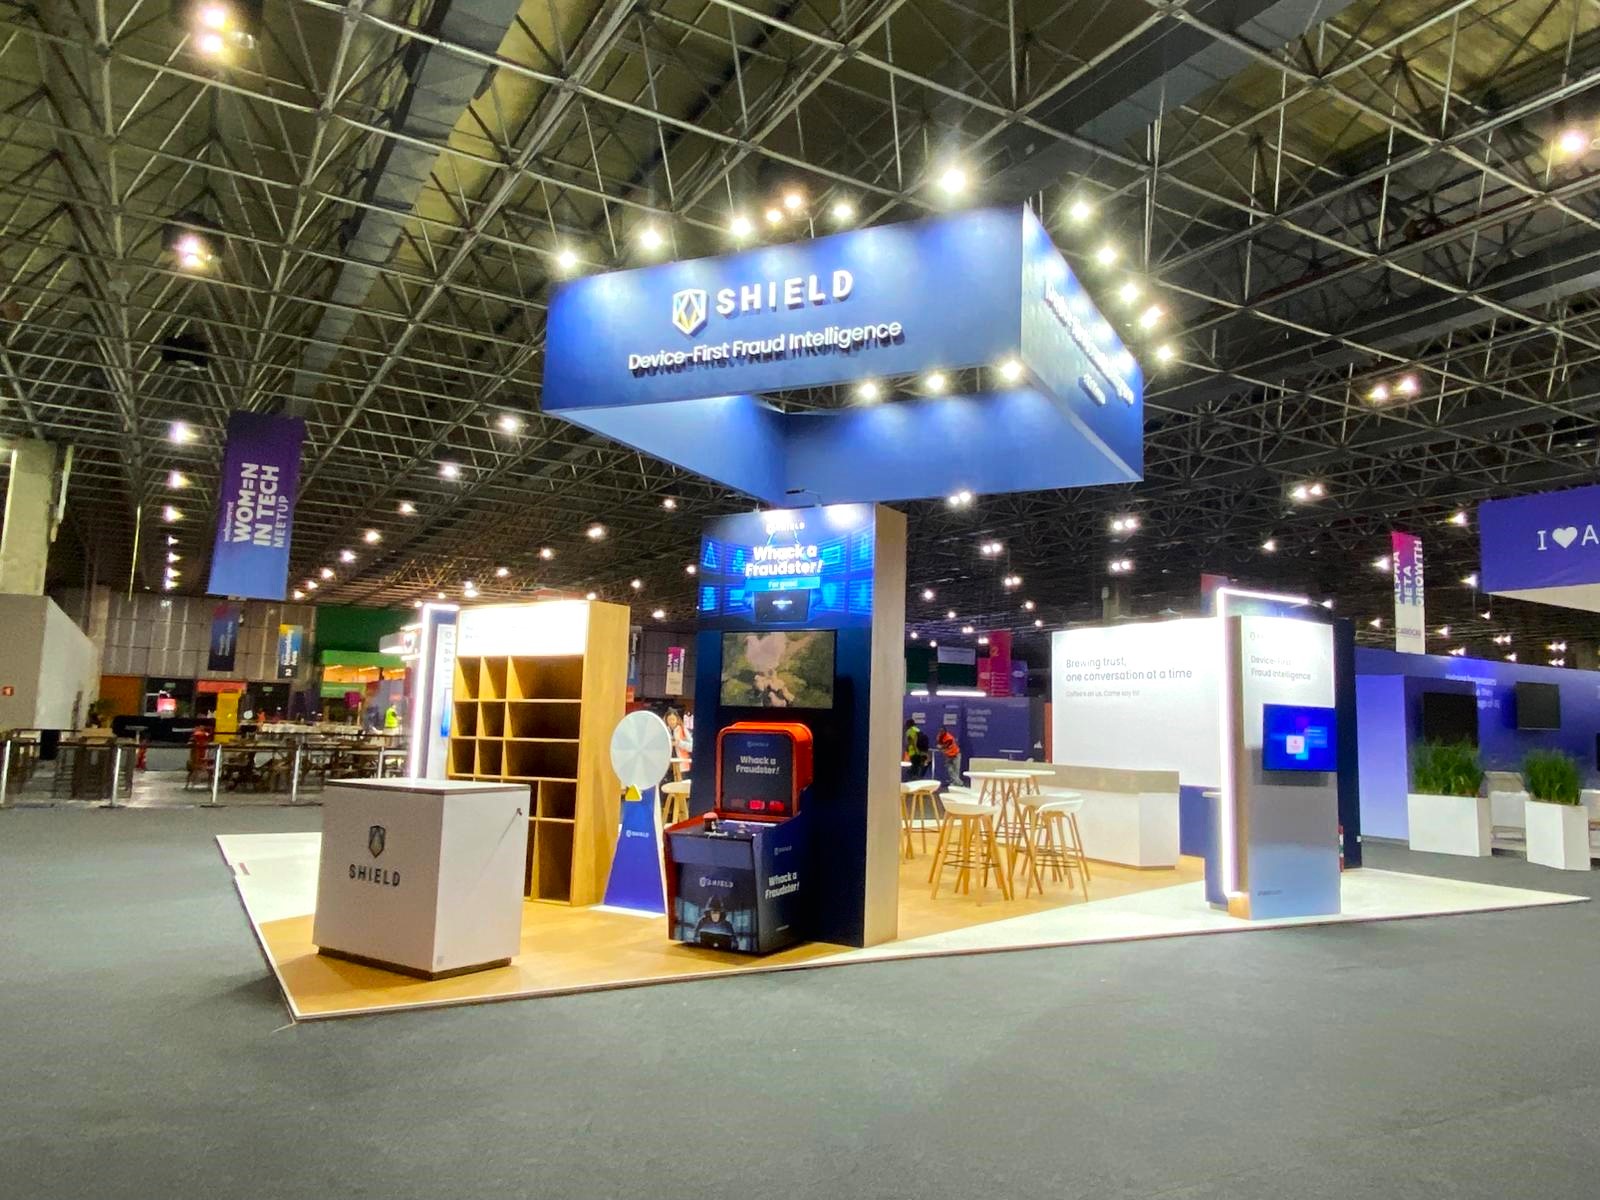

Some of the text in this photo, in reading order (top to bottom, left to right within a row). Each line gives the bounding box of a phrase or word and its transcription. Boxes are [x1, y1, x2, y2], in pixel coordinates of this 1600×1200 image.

[716, 270, 854, 315] SHIELD
[628, 321, 902, 370] Device-First Fraud Intelligence
[253, 465, 280, 546] IN TECH
[273, 495, 289, 548] MEETUP
[1537, 530, 1547, 551] I
[753, 544, 817, 560] Whack a
[745, 559, 824, 577] Fraudster!
[1066, 657, 1127, 670] Brewing trust,
[1066, 668, 1192, 682] one conversation at a time
[740, 755, 769, 765] Whack
[735, 764, 780, 775] Fraudster!
[349, 864, 401, 887] SHIELD
[768, 873, 792, 886] Whack
[764, 882, 800, 900] Fraudster!
